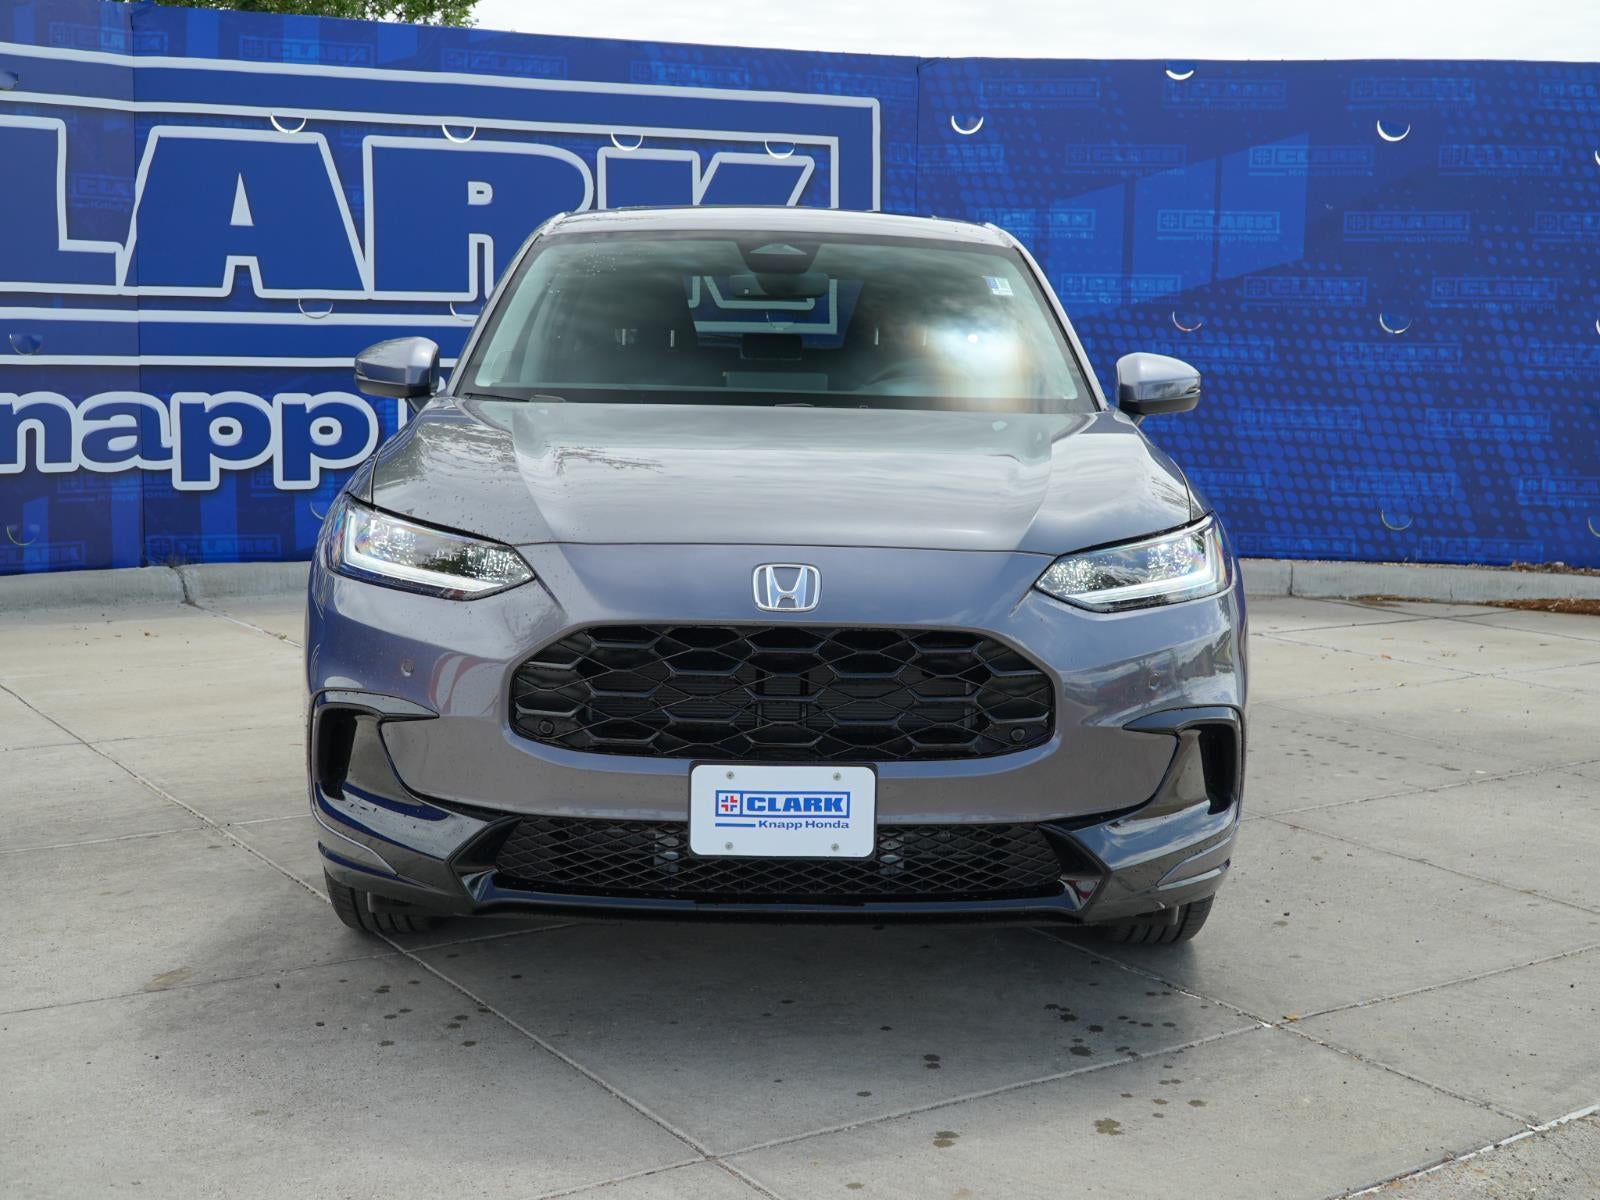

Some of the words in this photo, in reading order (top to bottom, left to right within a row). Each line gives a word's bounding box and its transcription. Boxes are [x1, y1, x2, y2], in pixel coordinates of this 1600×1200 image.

[1277, 149, 1369, 164] CLARK
[1185, 214, 1273, 229] CLARK
[1374, 215, 1462, 230] CLARK
[1238, 233, 1280, 242] Honda
[1087, 278, 1176, 293] CLARK
[1271, 280, 1362, 296] CLARK
[1461, 281, 1552, 297] CLARK
[747, 797, 843, 812] CLARK
[758, 820, 802, 831] Knapp
[805, 820, 849, 829] Honda
